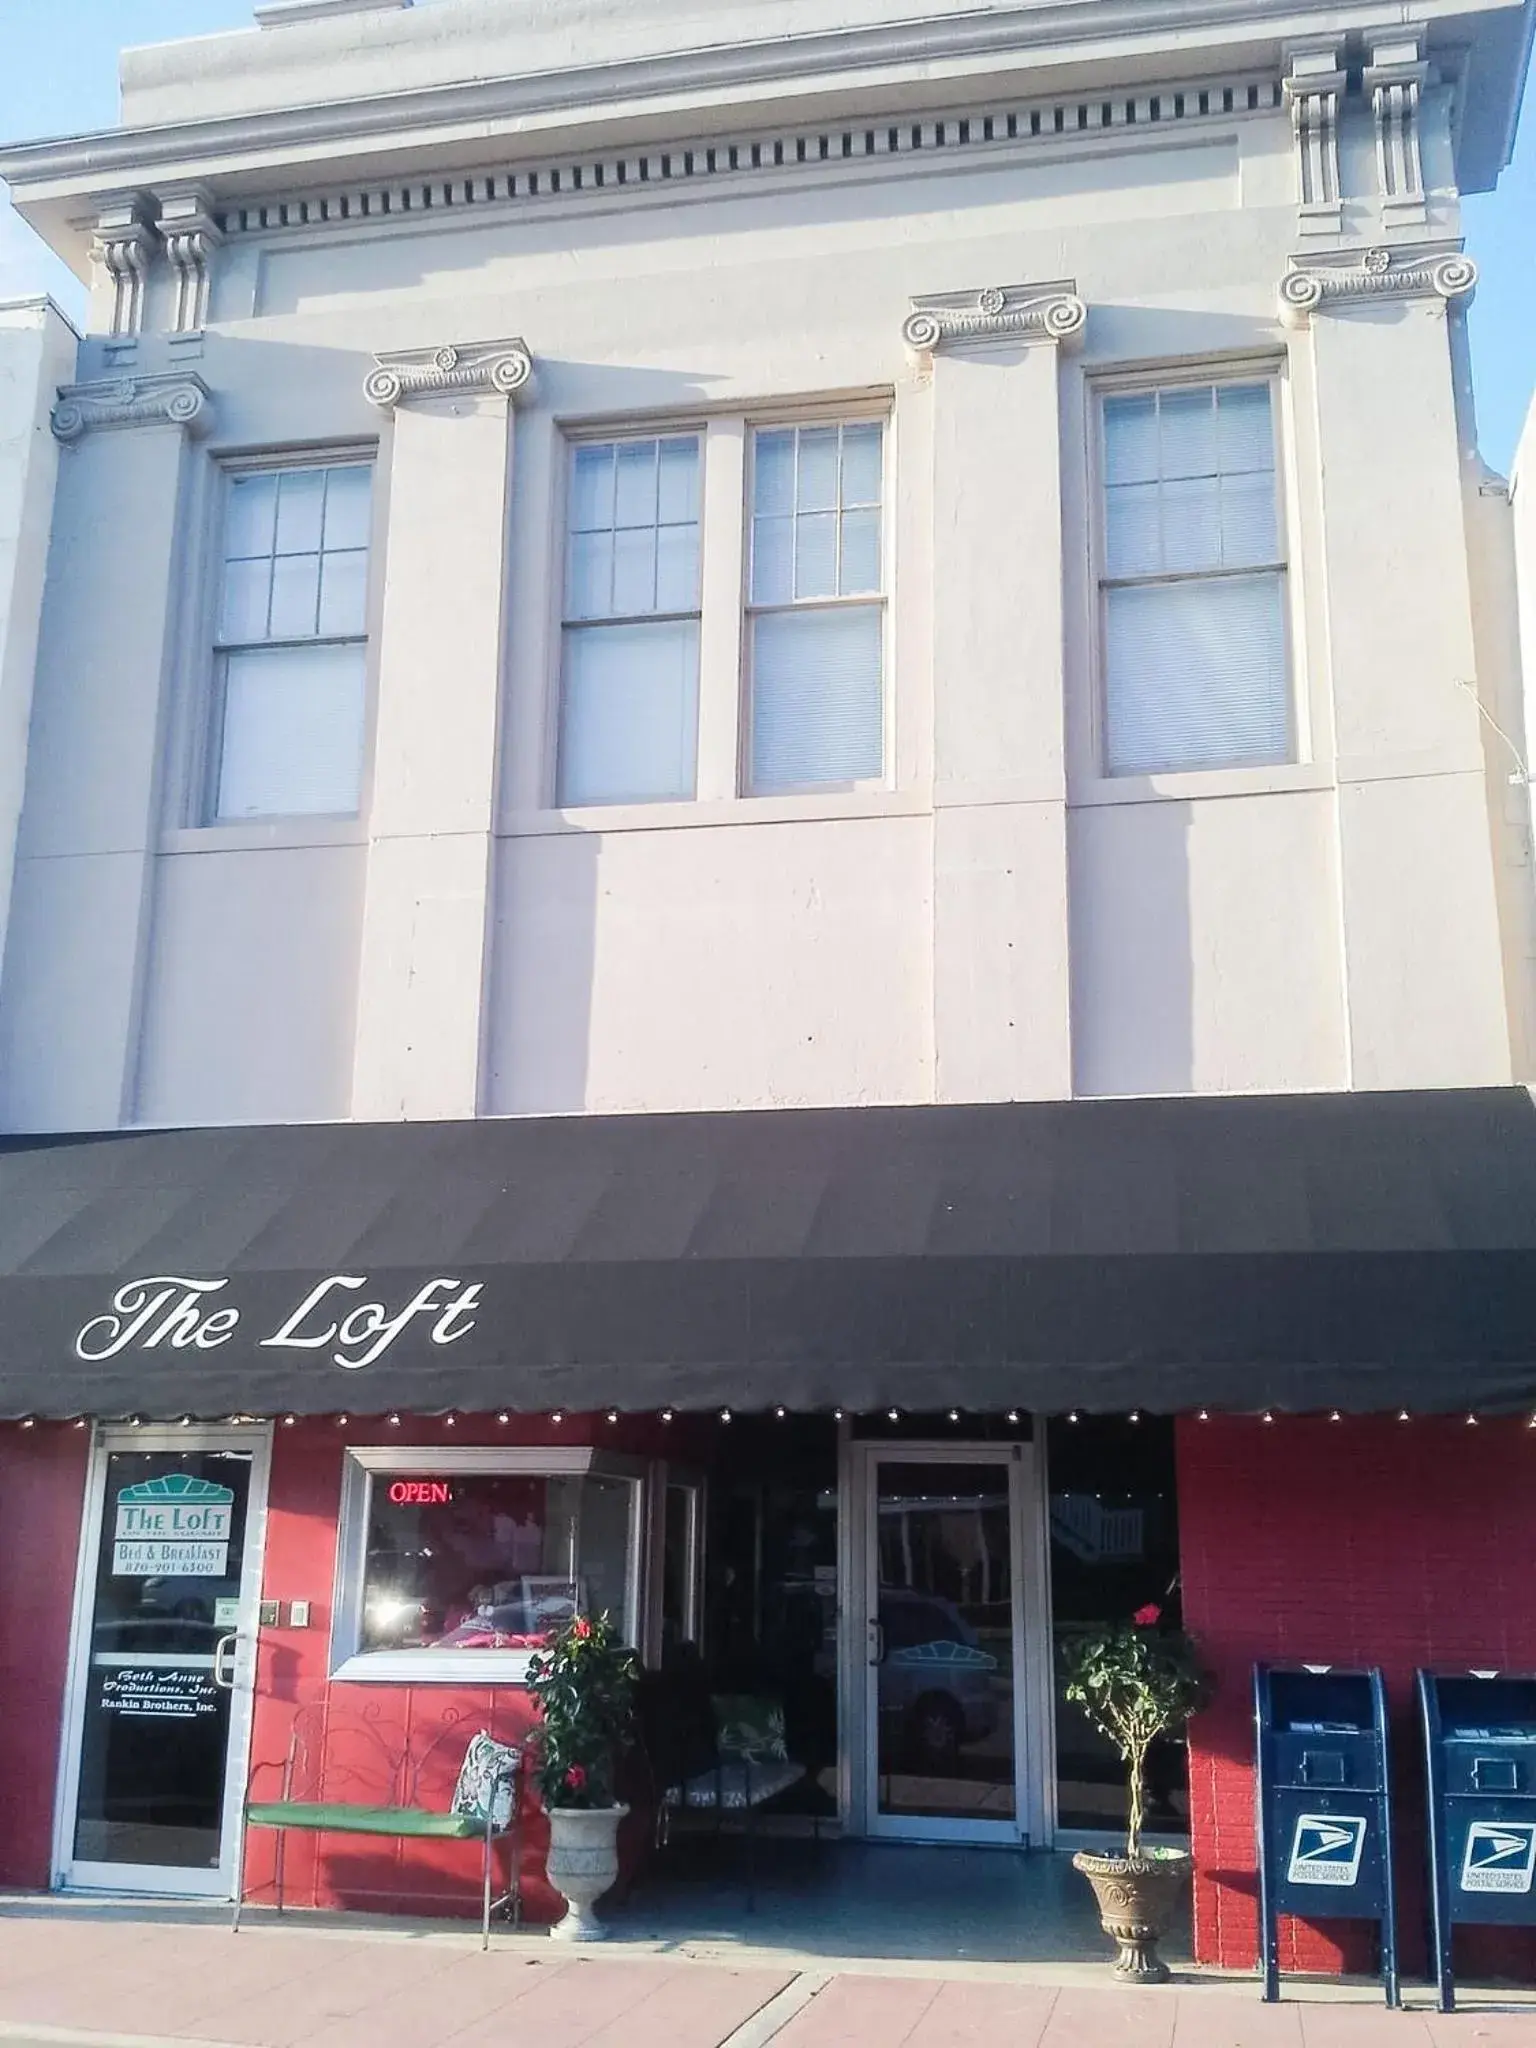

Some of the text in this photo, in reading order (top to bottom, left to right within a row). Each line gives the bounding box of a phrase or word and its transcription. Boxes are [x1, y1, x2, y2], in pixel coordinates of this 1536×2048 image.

[75, 1274, 486, 1370] The Loft
[390, 1482, 448, 1502] OPEN
[147, 1544, 155, 1560] &
[158, 1671, 205, 1683] Anne
[188, 1684, 217, 1695] Inc.
[101, 1698, 140, 1709] Rankin
[196, 1702, 217, 1712] Inc.
